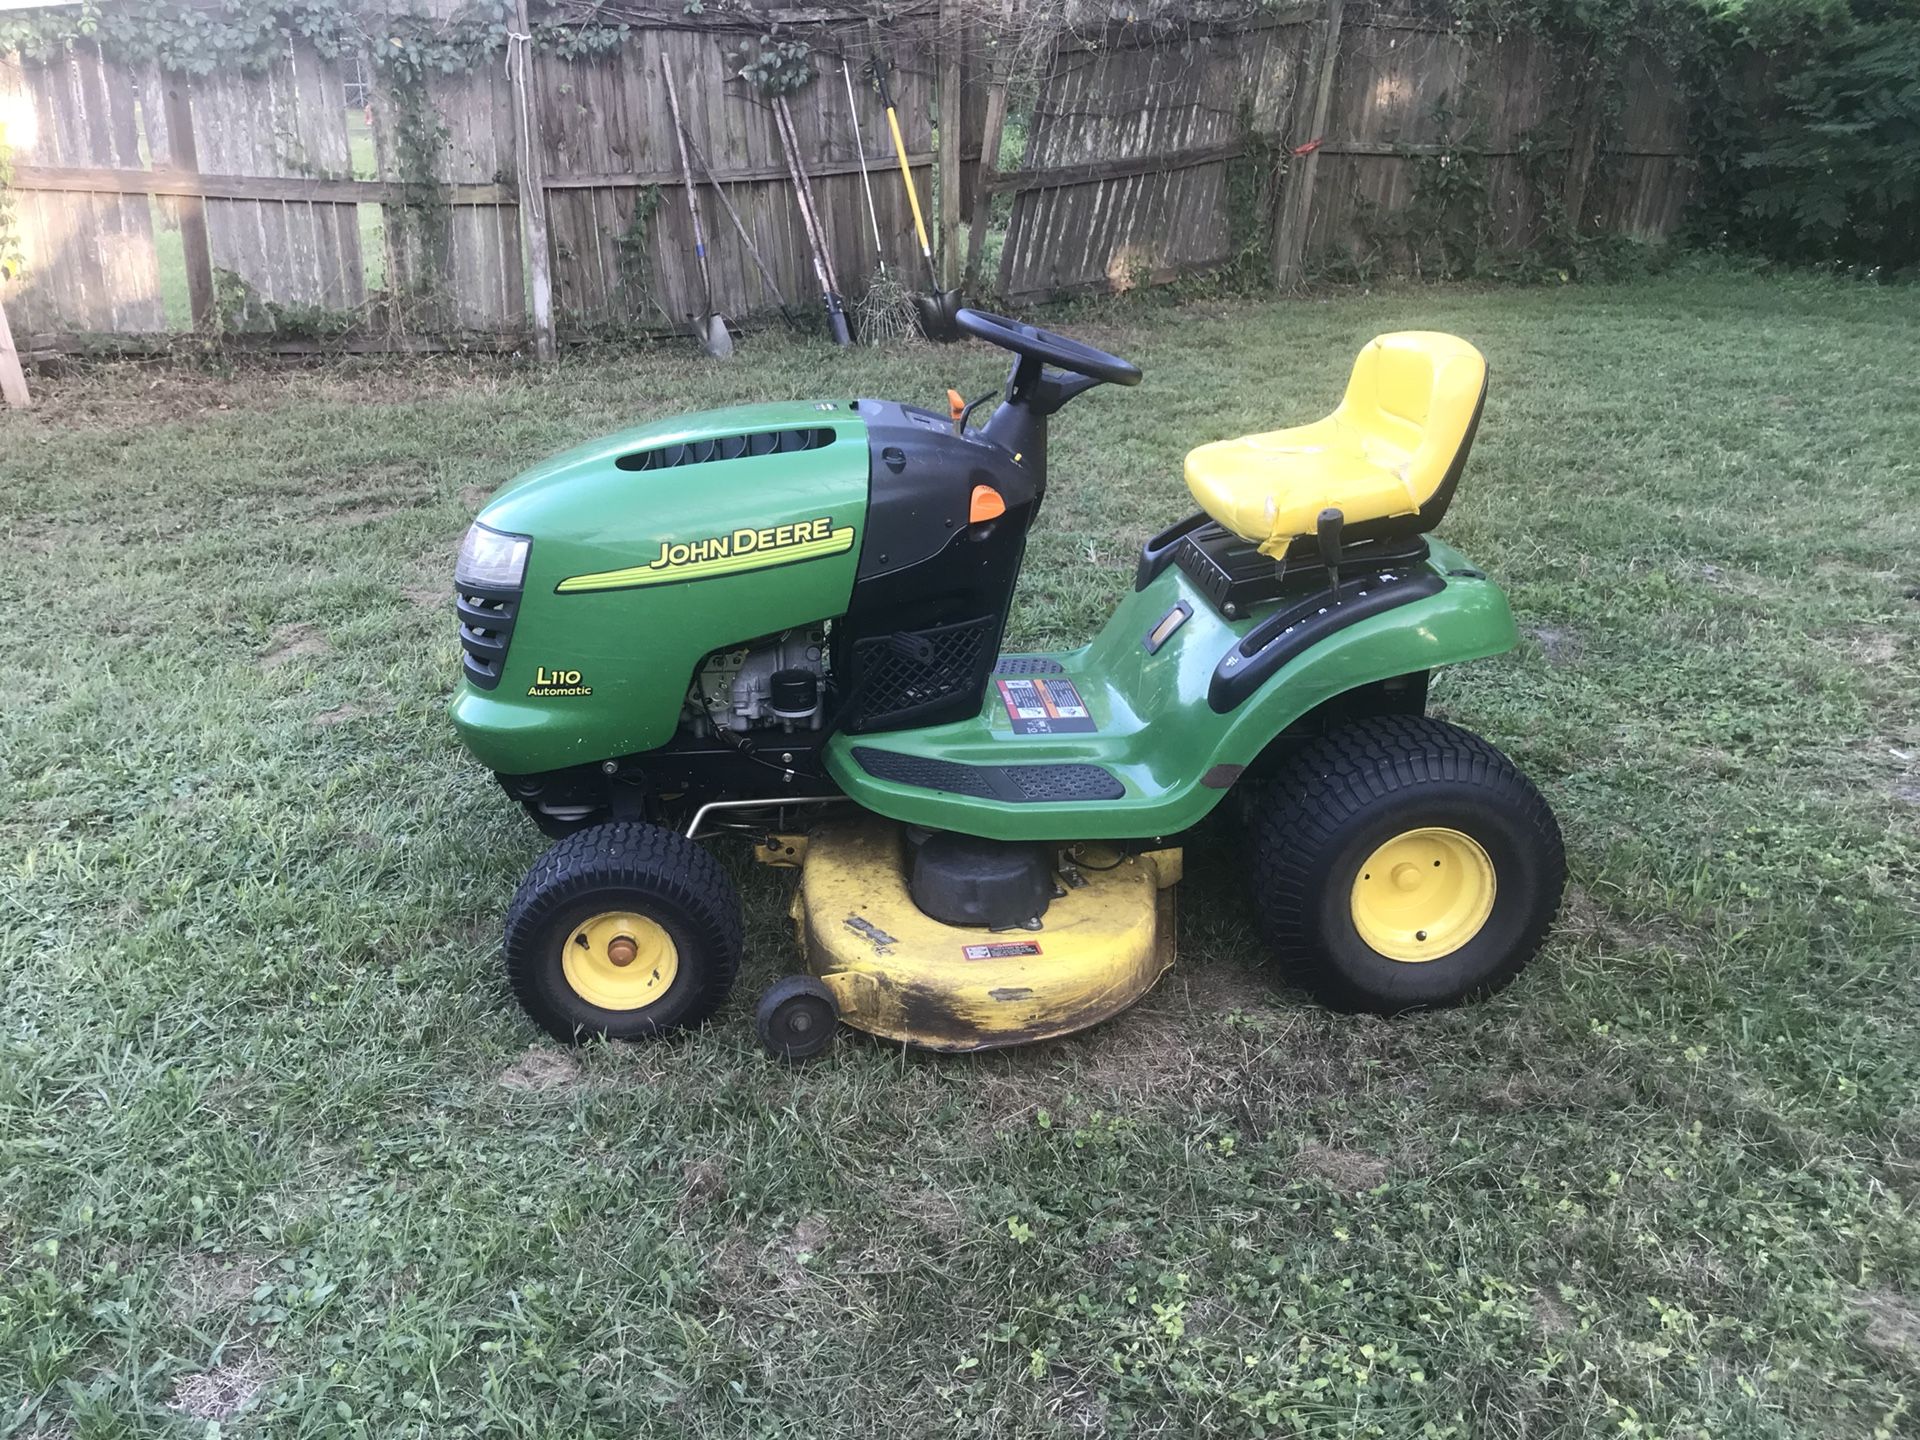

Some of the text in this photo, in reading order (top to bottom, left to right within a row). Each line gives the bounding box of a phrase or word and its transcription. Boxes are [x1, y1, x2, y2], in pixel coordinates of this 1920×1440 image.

[650, 517, 831, 568] JOHN DEERE
[537, 667, 581, 685] L110
[527, 685, 592, 696] Automatic
